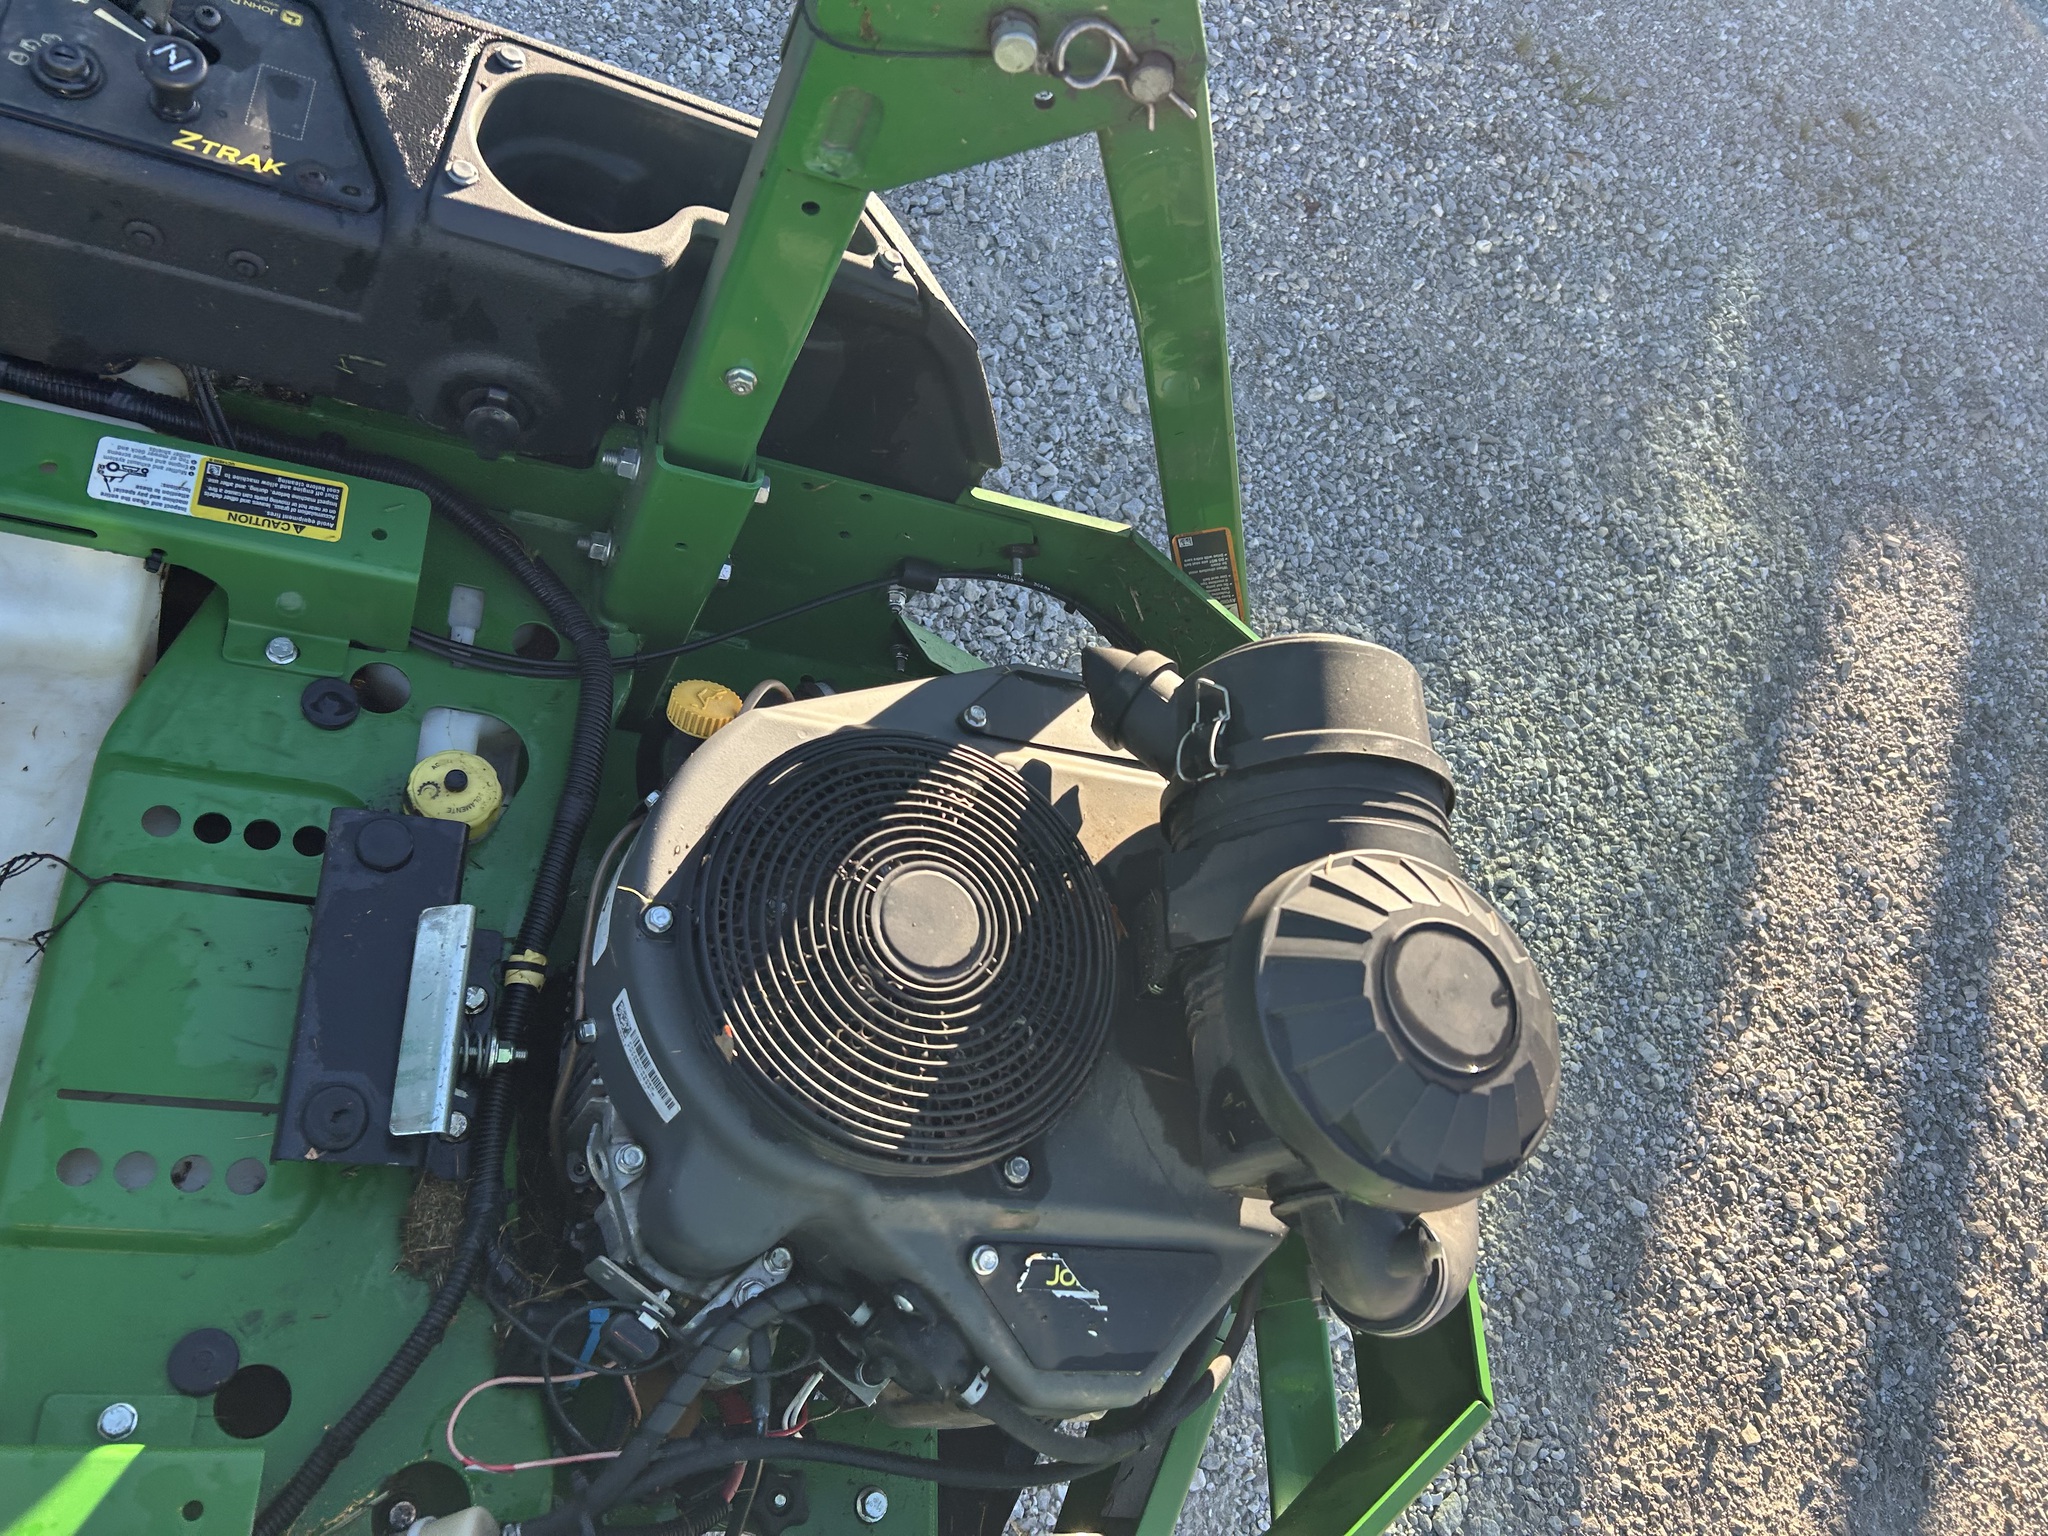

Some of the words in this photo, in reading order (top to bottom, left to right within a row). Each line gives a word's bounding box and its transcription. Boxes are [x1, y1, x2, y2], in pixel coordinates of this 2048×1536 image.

[242, 0, 278, 15] JOHN
[172, 130, 287, 176] ZTRAK
[107, 449, 131, 458] screens
[132, 454, 154, 462] engine
[147, 451, 169, 459] mower
[103, 454, 126, 463] system
[175, 456, 190, 464] Top
[127, 459, 151, 468] exhaust
[168, 461, 189, 469] Engine
[165, 467, 187, 475] Muffler
[232, 475, 260, 484] machine
[261, 480, 278, 488] allow
[276, 477, 305, 487] cleaning.
[113, 487, 136, 496] special
[293, 485, 314, 494] engine
[305, 483, 325, 491] before
[100, 491, 119, 499] entire
[161, 490, 190, 499] attention
[204, 491, 223, 499] debris
[254, 494, 269, 502] parts
[291, 494, 316, 503] machine
[325, 492, 339, 500] Shut
[132, 497, 149, 505] clean
[160, 496, 189, 506] machine
[252, 500, 271, 508] leaves
[269, 496, 291, 505] moving
[317, 498, 338, 507] Inspect
[164, 503, 187, 512] Inspect
[264, 510, 281, 518] fires.
[282, 513, 316, 524] equipment
[297, 508, 336, 520] Accumulation
[227, 512, 291, 531] CAUTION
[316, 520, 334, 528] Avoid
[446, 791, 484, 814] OLAMENTE
[1045, 1264, 1081, 1287] JO
